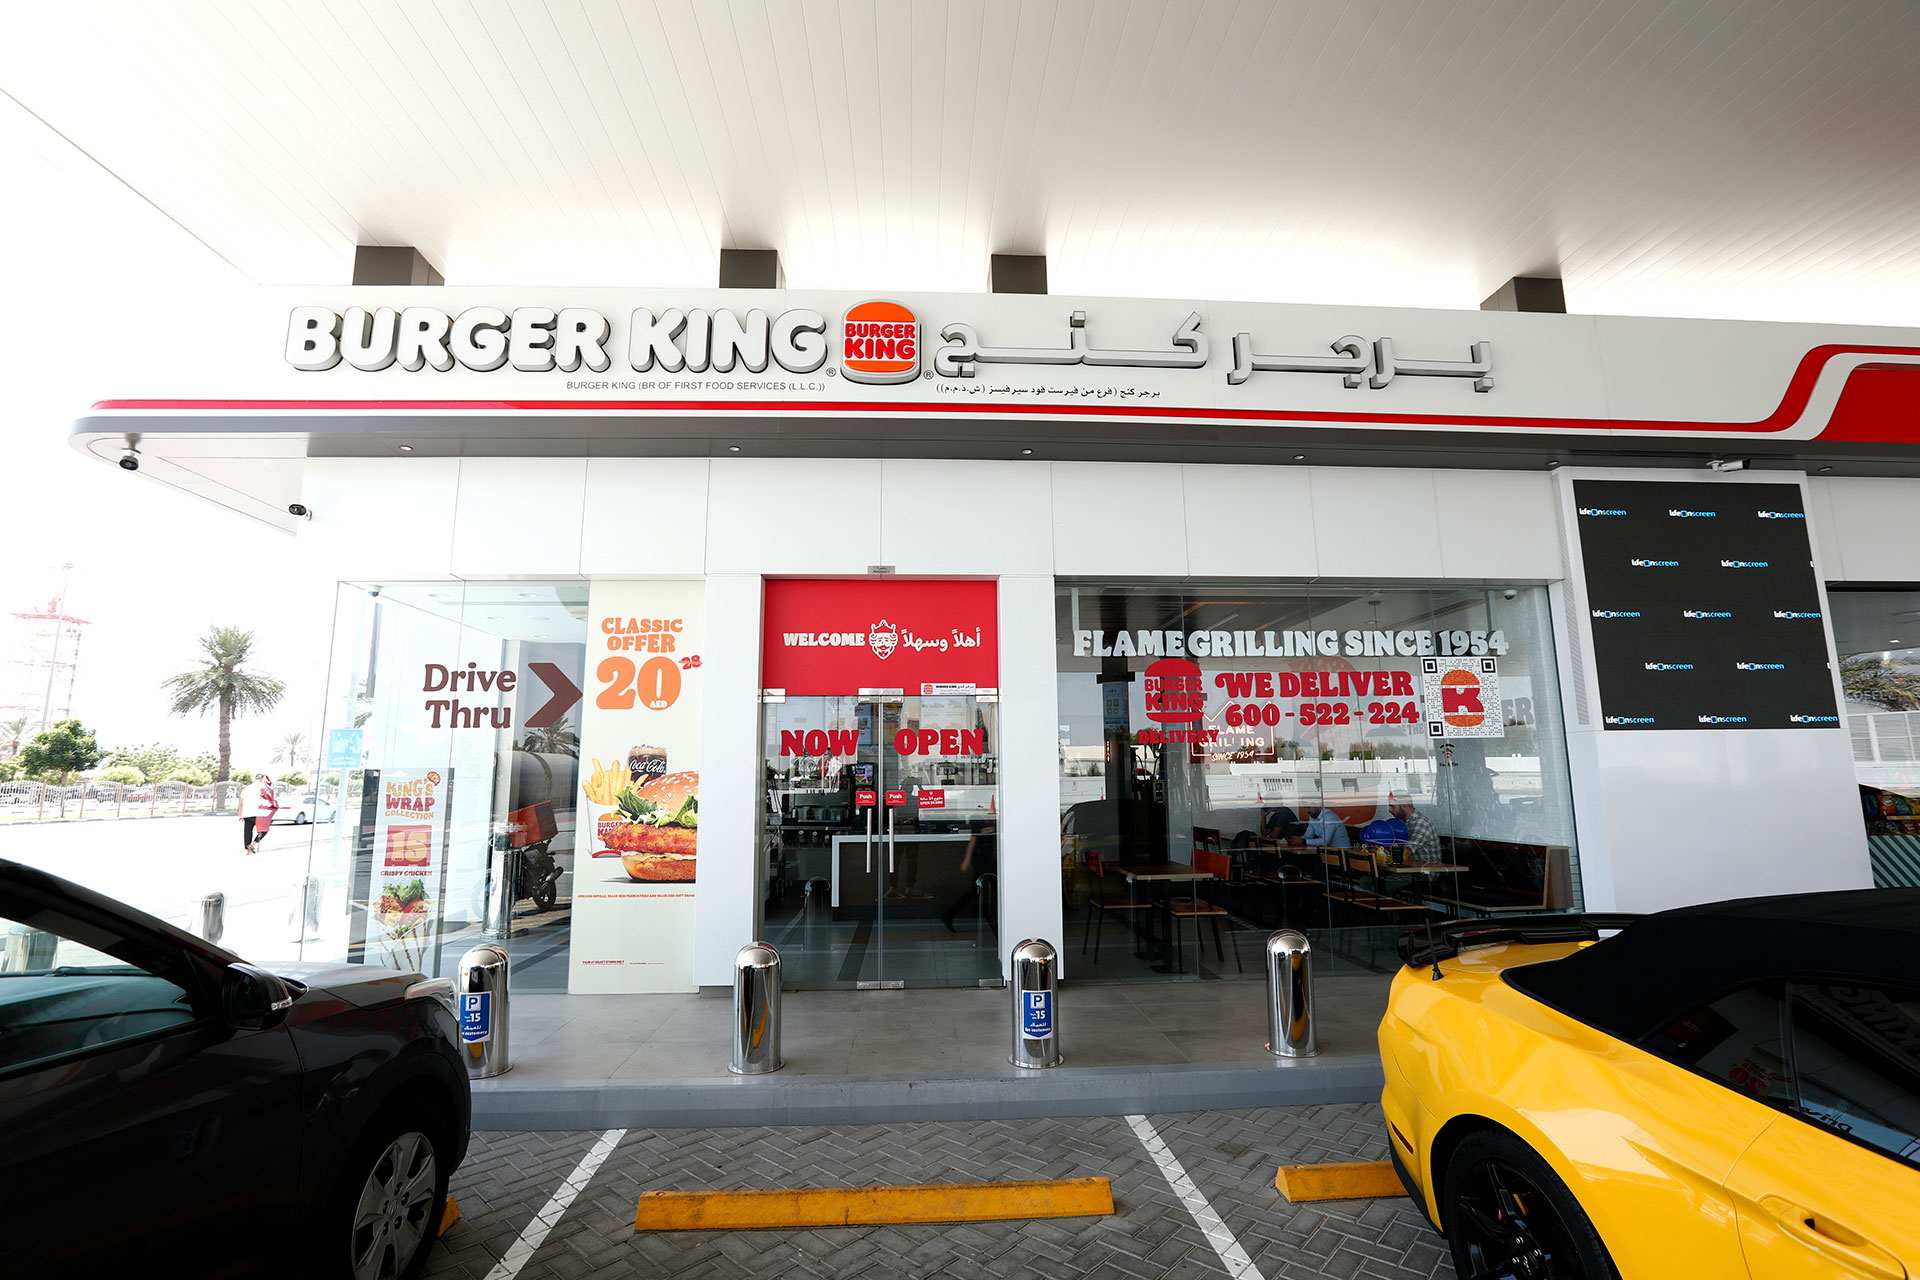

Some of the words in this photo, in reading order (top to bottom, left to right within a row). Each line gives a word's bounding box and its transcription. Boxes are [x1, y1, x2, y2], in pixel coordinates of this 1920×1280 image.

[845, 323, 915, 338] BURGER
[285, 306, 611, 372] BURGER
[627, 306, 830, 374] KING
[845, 338, 916, 359] KING
[1226, 332, 1495, 393] برجر
[566, 381, 609, 390] BURGER
[611, 381, 636, 390] KING
[638, 381, 656, 391] (BR
[658, 381, 672, 390] OF
[674, 381, 702, 390] FIRST
[705, 381, 734, 390] FOOD
[736, 381, 786, 391] SERVICES
[1030, 386, 1046, 396] فود
[1048, 384, 1079, 397] فيرست
[1081, 386, 1095, 396] من
[1119, 385, 1136, 397] كنج
[1138, 388, 1161, 399] برجر
[601, 617, 683, 634] CLASSIC
[607, 634, 676, 653] OFFER
[784, 633, 865, 646] WELCOME
[1073, 630, 1184, 656] FLAME
[1187, 630, 1339, 656] GRILLING
[1345, 630, 1434, 656] SINCE
[1439, 630, 1509, 656] 1954
[423, 662, 517, 693] Drive
[596, 656, 682, 710] 20
[1144, 678, 1202, 692] BURGER
[1215, 672, 1274, 698] WE
[1279, 671, 1414, 698] DELIVER
[1146, 692, 1206, 711] KING
[425, 699, 511, 728] Thru
[781, 730, 859, 756] NOW
[894, 728, 984, 756] OPEN
[1138, 729, 1219, 744] DELIVERY
[386, 795, 435, 811] WRAP
[391, 831, 427, 861] 15
[469, 997, 478, 1009] P
[1033, 995, 1042, 1007] P
[470, 1013, 481, 1022] 15
[1036, 1010, 1045, 1019] 15
